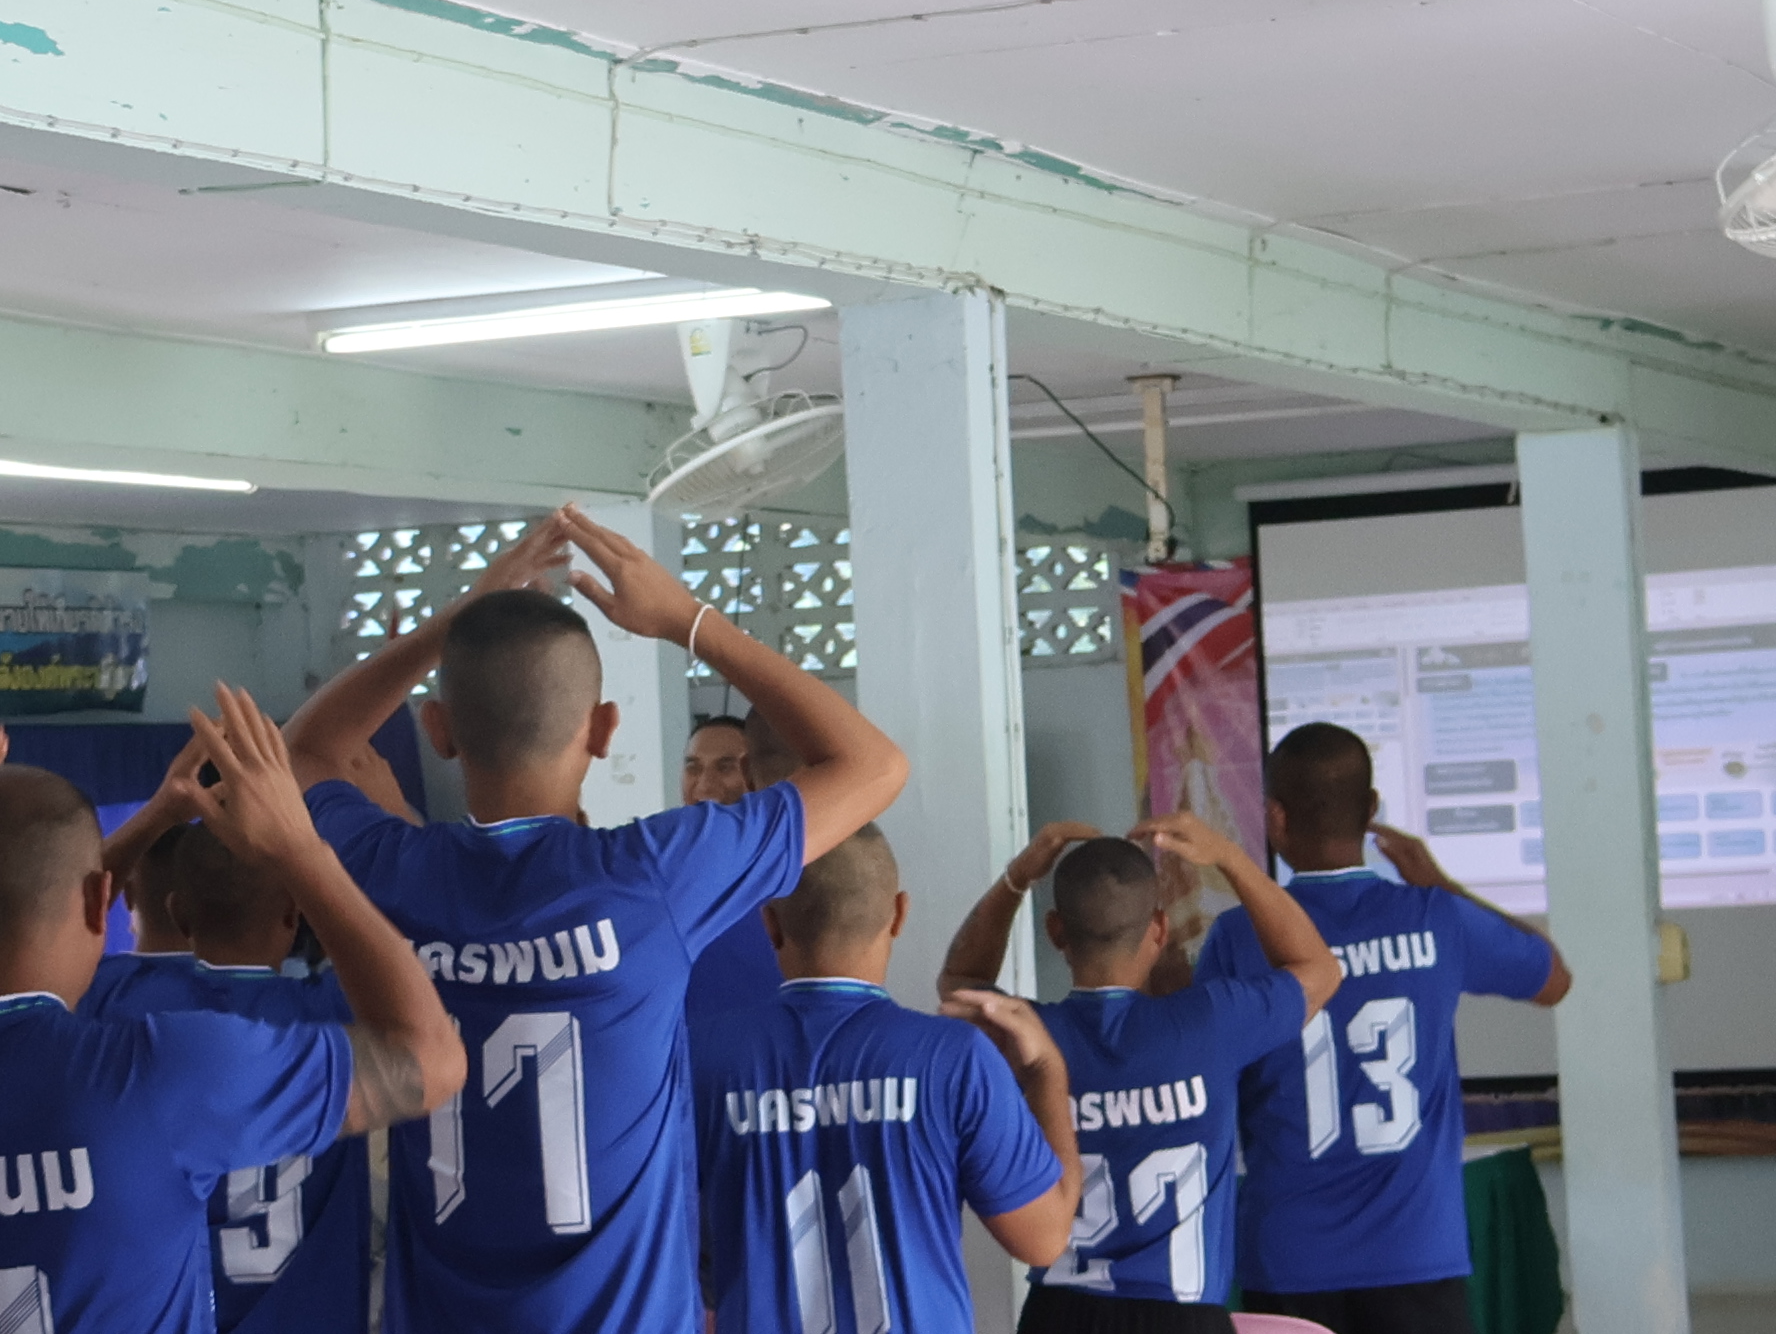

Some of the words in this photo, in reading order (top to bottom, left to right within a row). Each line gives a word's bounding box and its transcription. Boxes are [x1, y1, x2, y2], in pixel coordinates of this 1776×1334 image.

[408, 918, 620, 984] ครพนม
[1330, 931, 1437, 977] รพนม
[726, 1077, 917, 1135] นครพนม
[1068, 1075, 1208, 1132] รพนม
[1302, 997, 1421, 1159] 13
[428, 1011, 592, 1234] 17
[1045, 1142, 1208, 1303] 27
